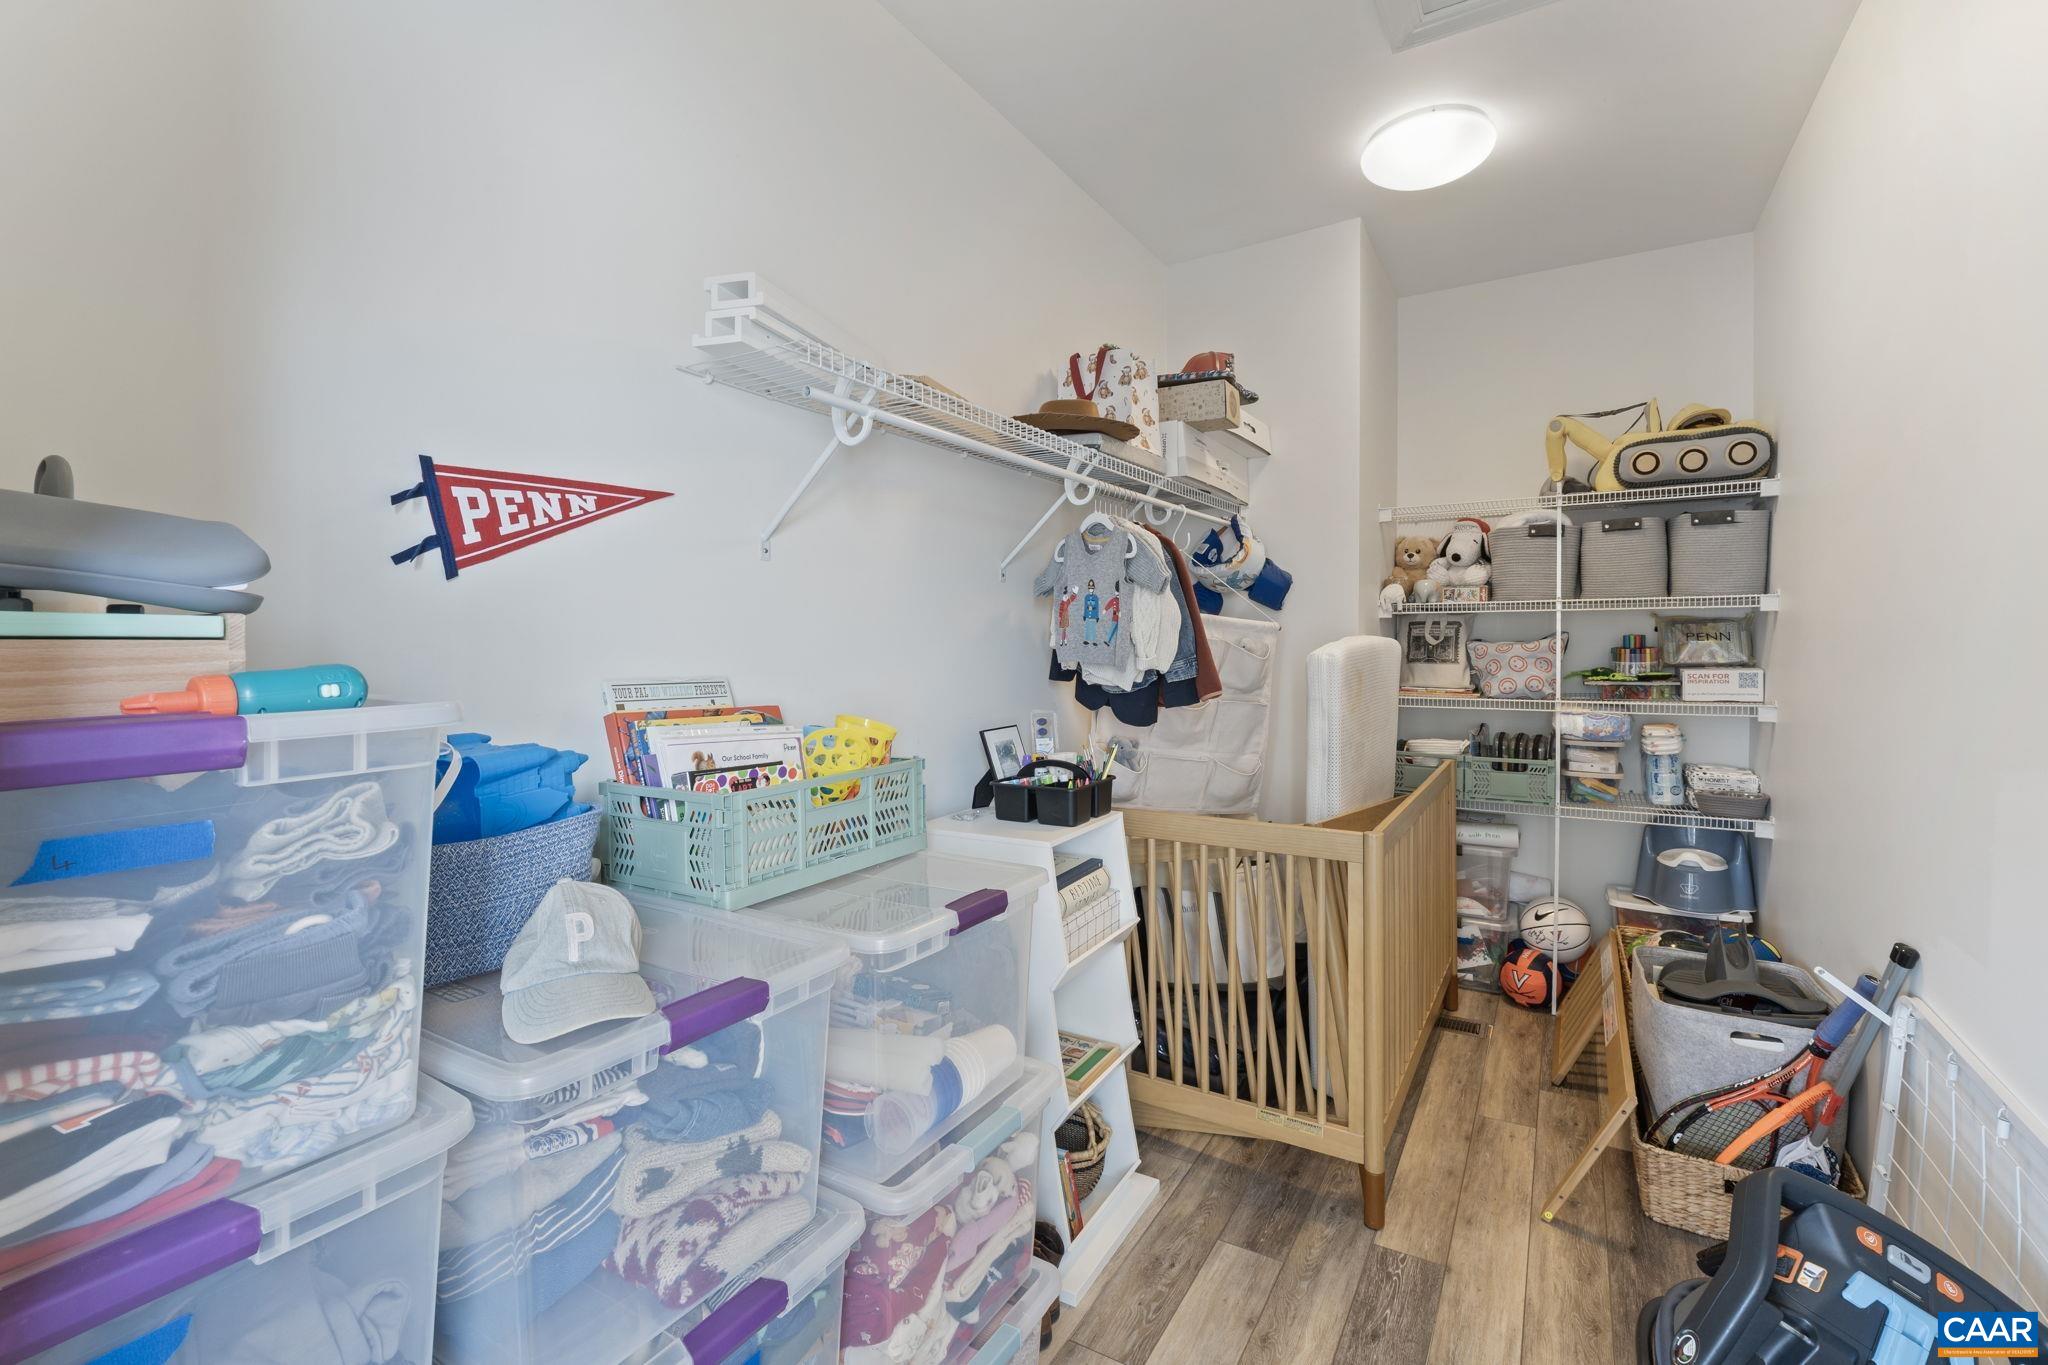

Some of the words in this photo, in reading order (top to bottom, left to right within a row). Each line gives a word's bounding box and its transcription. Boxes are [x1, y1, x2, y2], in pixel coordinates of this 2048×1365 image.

[451, 486, 597, 545] PENN
[1686, 632, 1731, 641] PENN
[612, 687, 633, 699] YOUR
[634, 687, 649, 698] PAL
[694, 684, 728, 696] PRESENTS
[565, 912, 595, 962] P
[1512, 969, 1532, 991] V
